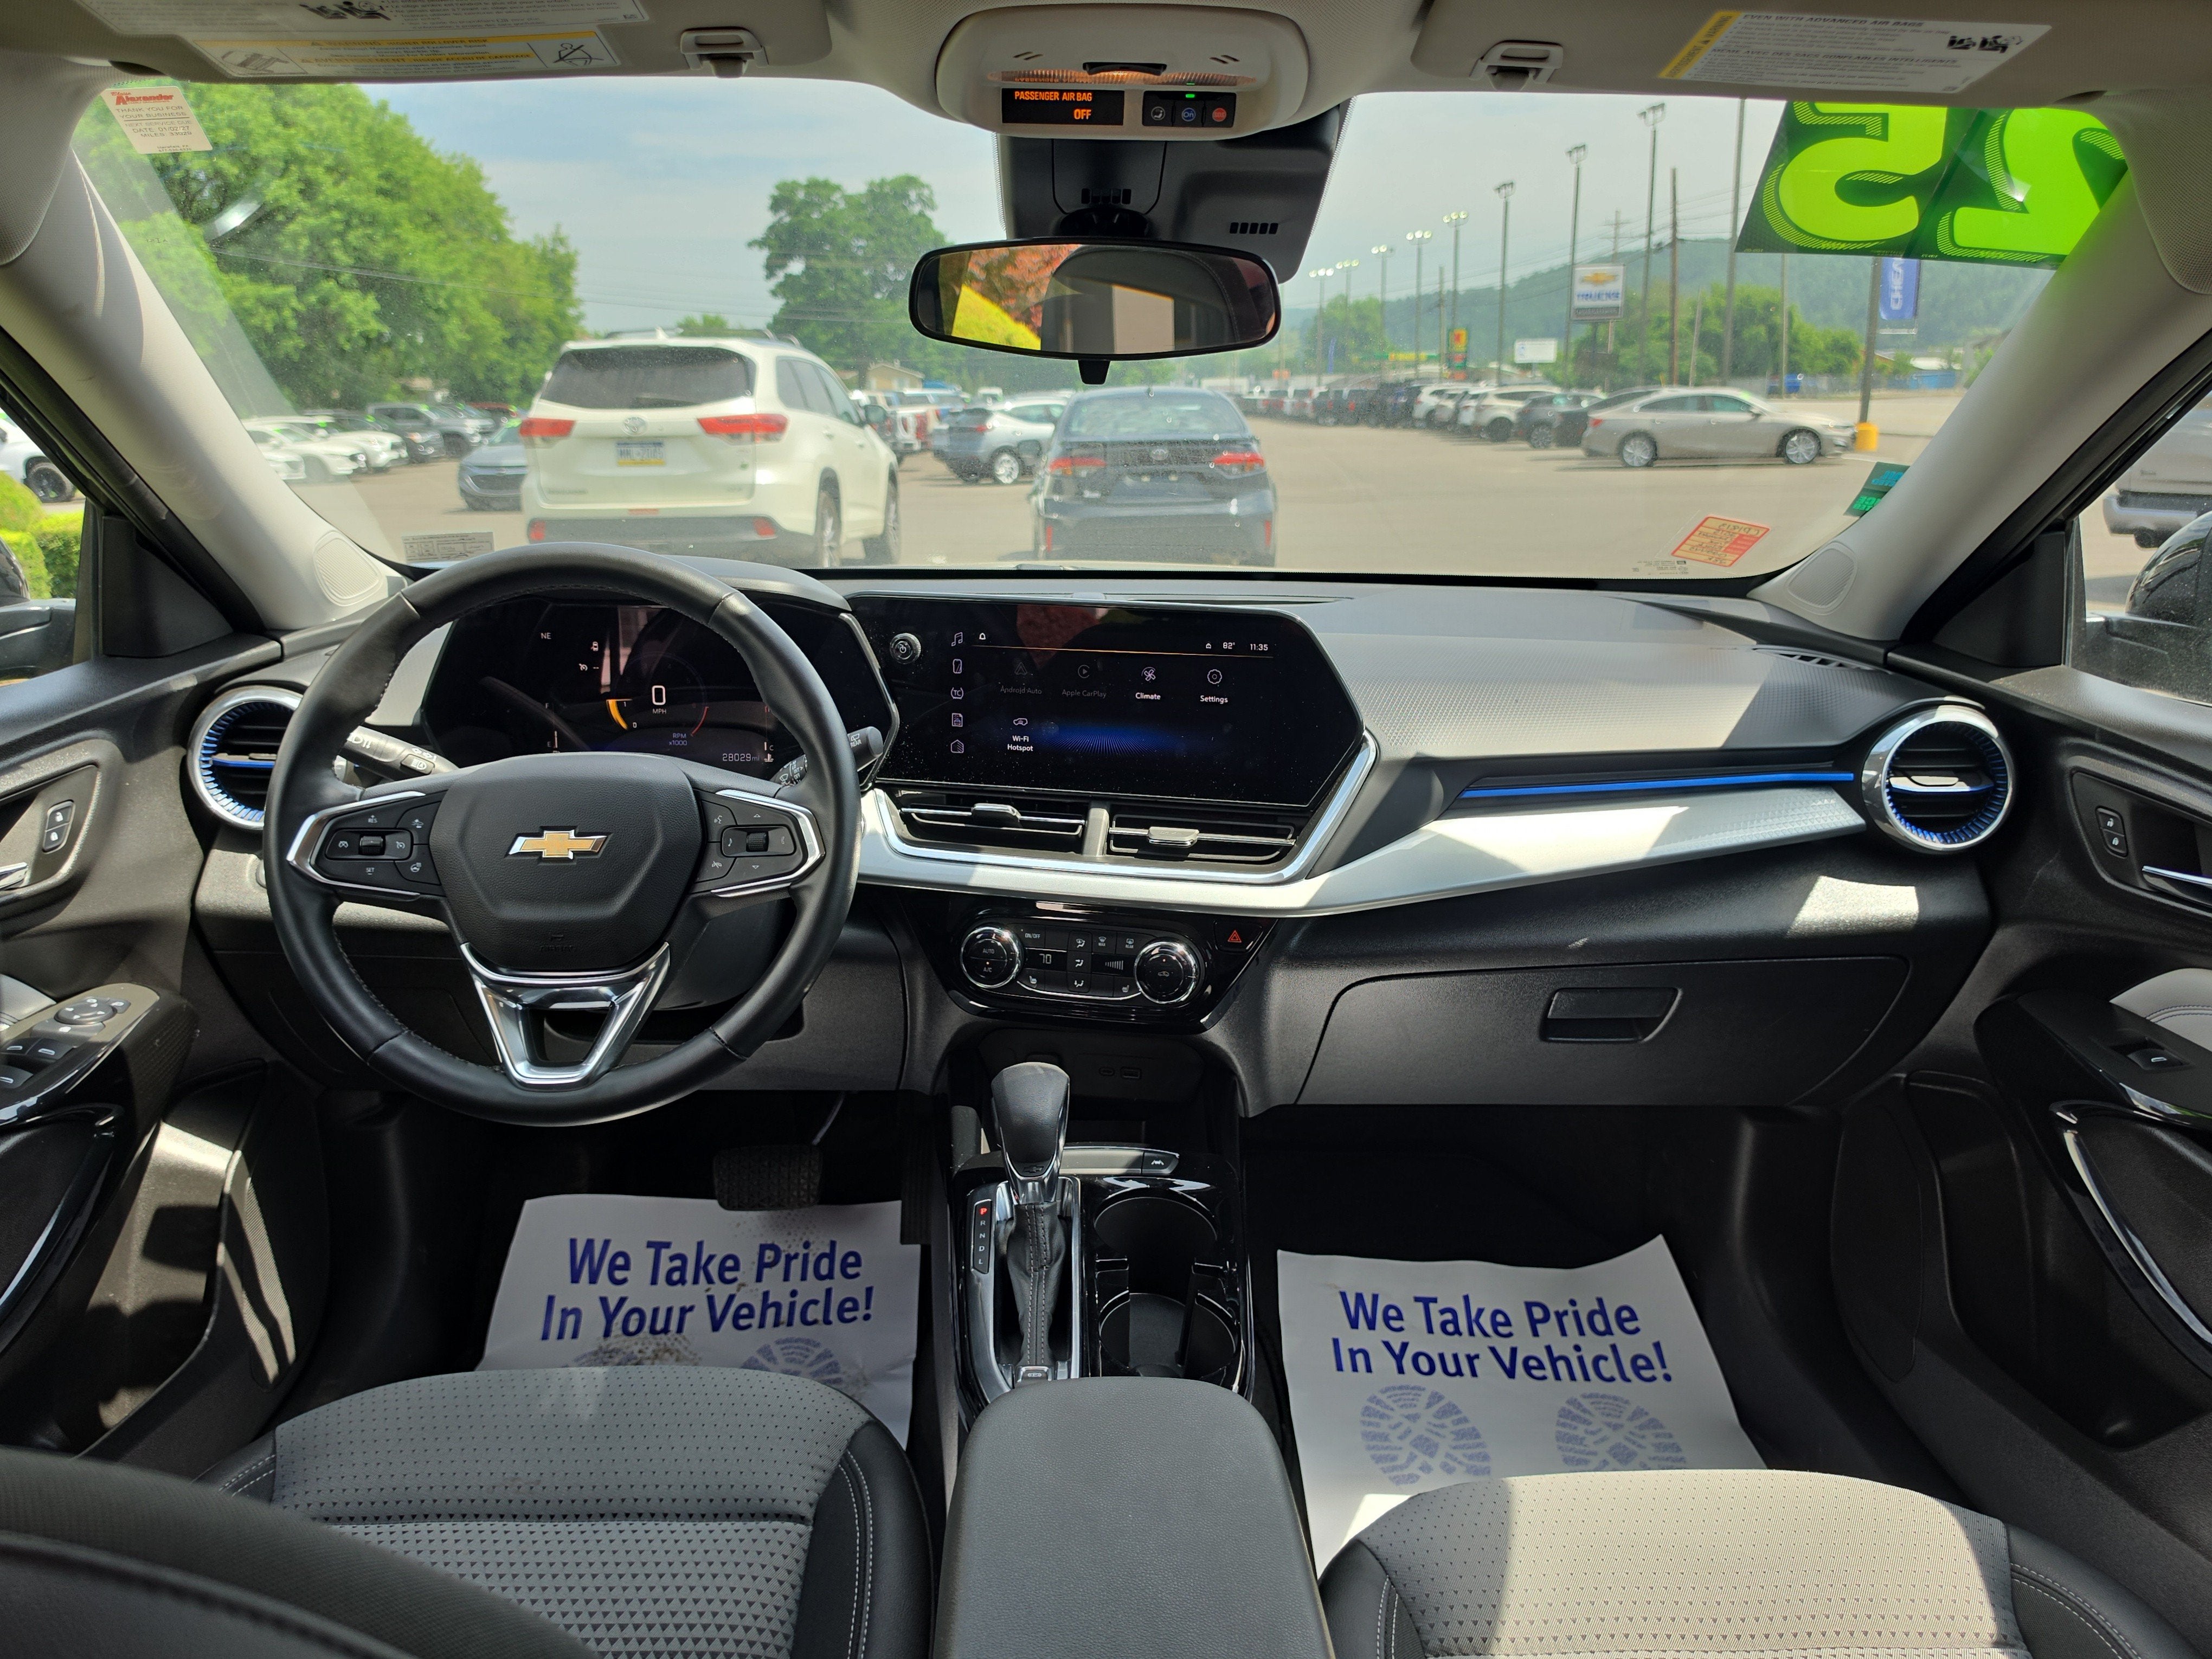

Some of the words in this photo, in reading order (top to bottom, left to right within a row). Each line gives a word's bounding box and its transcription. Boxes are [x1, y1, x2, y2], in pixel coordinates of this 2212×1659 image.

[1805, 17, 1868, 25] ADVANCED
[115, 94, 174, 106] Alexander
[1014, 91, 1059, 101] PASSENGER
[1062, 92, 1075, 101] AIR
[1076, 92, 1092, 102] BAG
[1073, 109, 1092, 120] OFF
[1250, 643, 1269, 651] 11:35
[652, 685, 666, 705] 0
[1000, 685, 1026, 695] Android
[1026, 686, 1042, 695] Auto
[1062, 689, 1081, 698] Apple
[1082, 690, 1107, 699] CarPlay
[1135, 692, 1161, 700] Climate
[1200, 695, 1229, 704] Settings
[850, 740, 862, 748] REAR
[1012, 735, 1030, 743] Wi-Fi
[1007, 743, 1033, 753] Hotspot
[1039, 953, 1052, 964] 70
[569, 1237, 631, 1286] We
[646, 1240, 741, 1287] Take
[755, 1240, 864, 1283] Pride
[539, 1294, 583, 1341] In
[599, 1295, 695, 1339] Your
[706, 1285, 874, 1333] Vehicle!
[1339, 1291, 1406, 1333] We
[1413, 1294, 1513, 1339] Take
[1523, 1297, 1642, 1338] Pride
[1332, 1338, 1373, 1374] In
[1381, 1341, 1481, 1378] Your
[1487, 1340, 1673, 1384] Vehicle!
